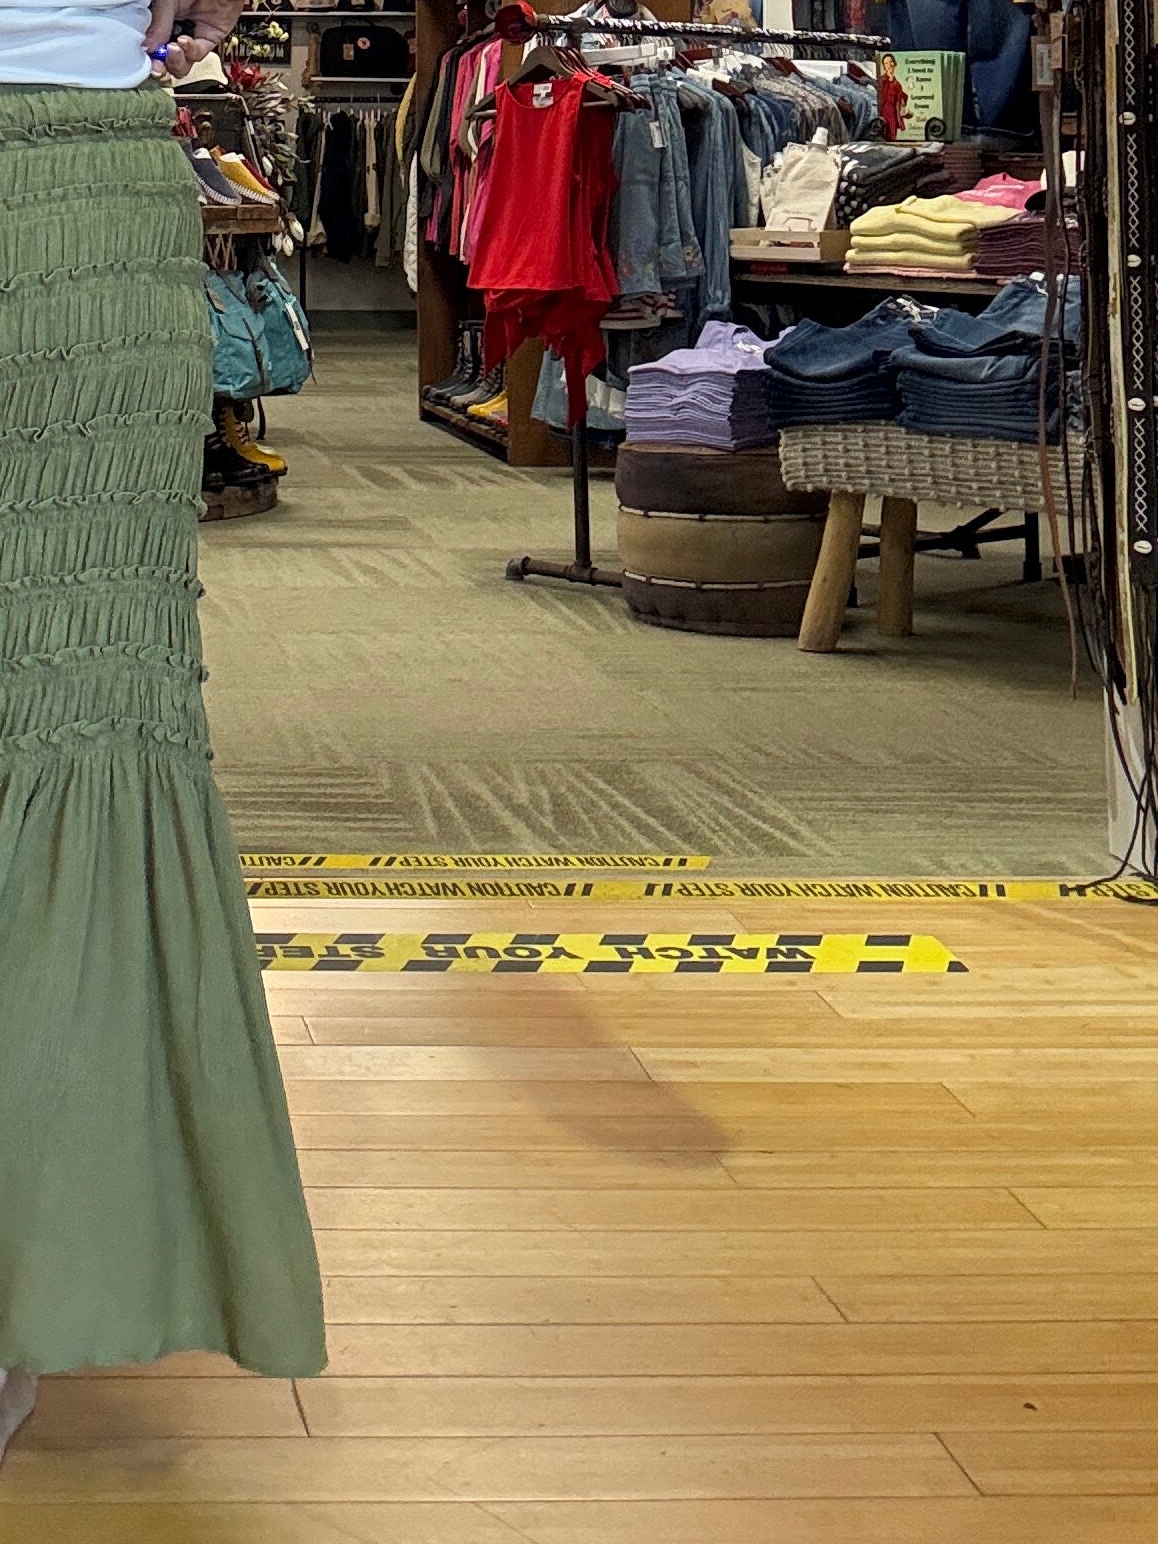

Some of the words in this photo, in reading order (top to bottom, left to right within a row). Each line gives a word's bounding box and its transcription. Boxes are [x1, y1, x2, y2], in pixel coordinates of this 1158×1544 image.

[241, 856, 296, 867] CAUTI
[399, 856, 449, 867] STEP
[454, 856, 504, 867] YOUR
[505, 856, 576, 867] WATCH
[579, 856, 661, 867] CAUTION
[264, 881, 321, 897] STEP
[322, 881, 384, 897] YOUR
[385, 881, 467, 897] WATCH
[466, 881, 562, 897] CAUTION
[677, 882, 736, 897] STEP
[734, 882, 795, 897] YOUR
[796, 882, 883, 897] WATCH
[877, 882, 977, 897] CAUTION
[256, 944, 386, 959] STEP
[421, 945, 584, 960] YOUR
[614, 945, 817, 960] WATCH
